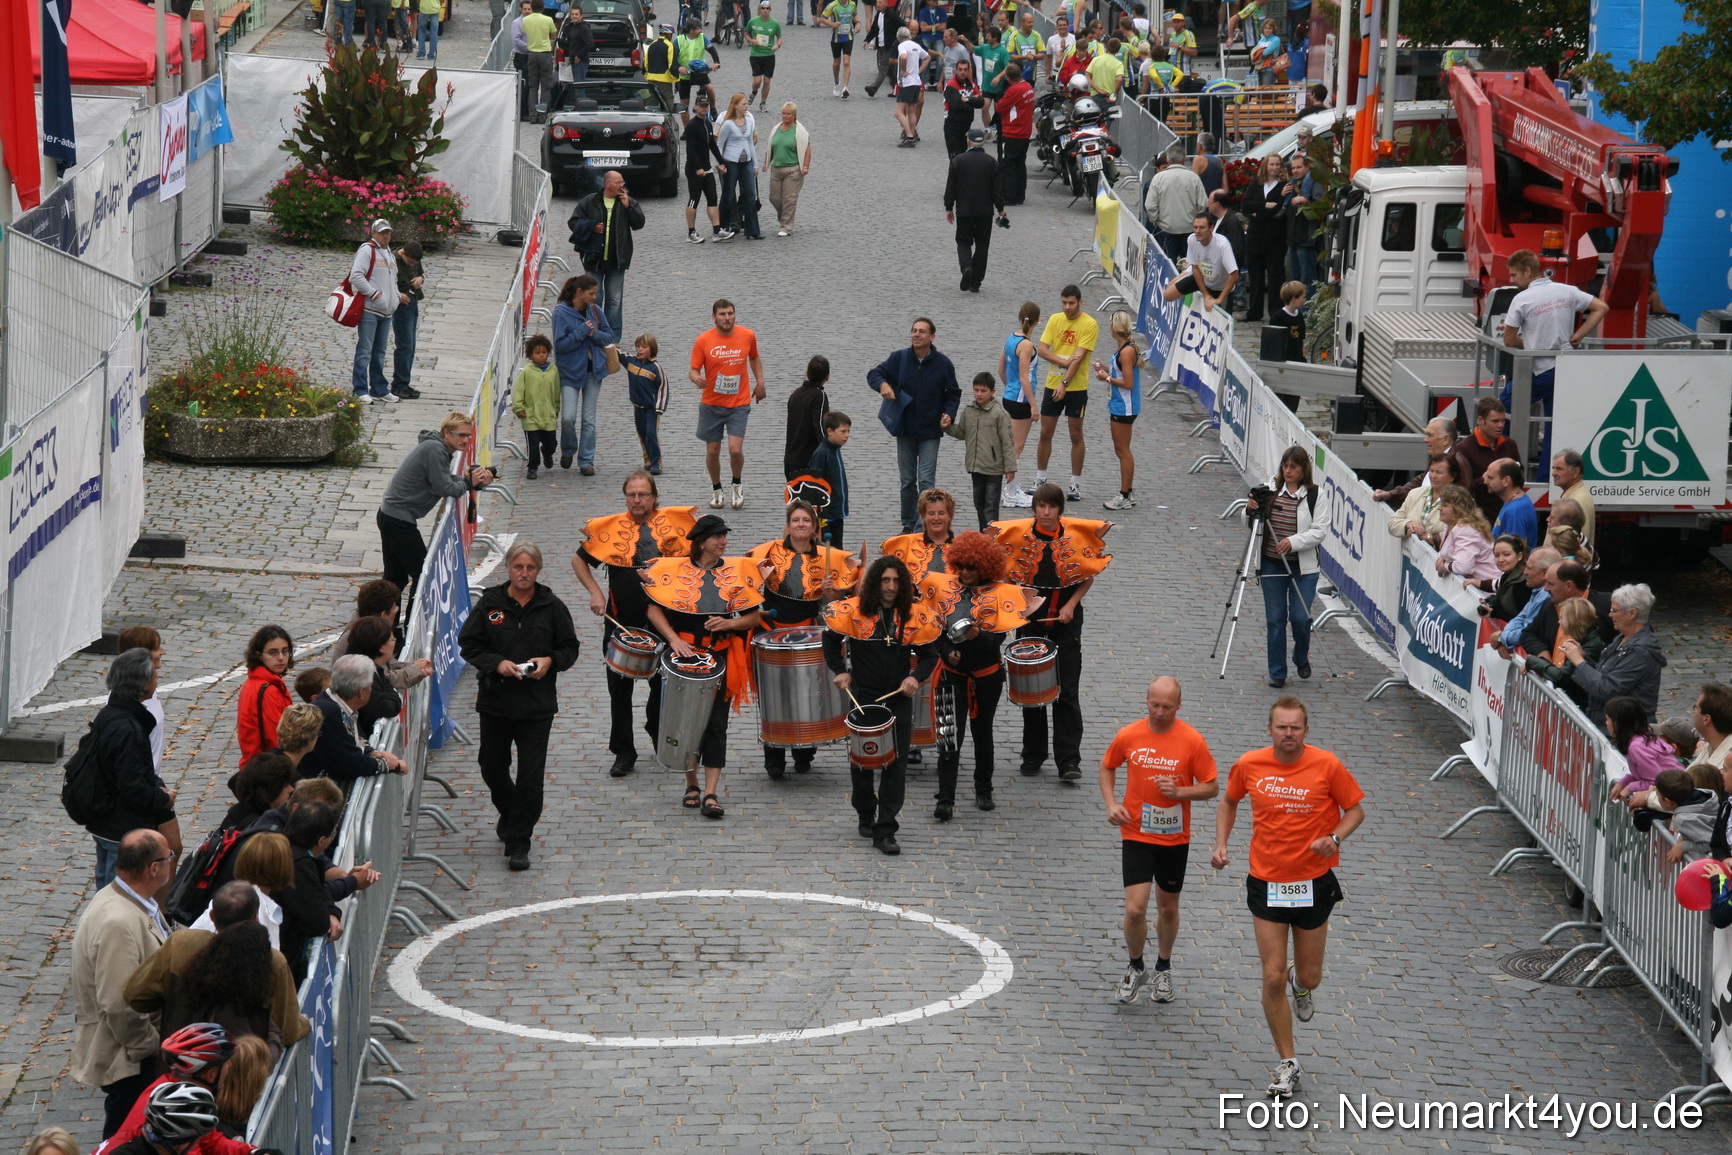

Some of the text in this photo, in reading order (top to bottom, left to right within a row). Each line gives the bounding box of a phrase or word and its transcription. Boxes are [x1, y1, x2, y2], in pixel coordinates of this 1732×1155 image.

[1086, 156, 1096, 164] NM
[1090, 162, 1102, 170] 308
[1589, 485, 1711, 497] Gebäude Service GmbH
[1415, 603, 1466, 670] Tagblatt
[1137, 753, 1180, 767] Fischer
[1141, 763, 1176, 771] AUTOMOBILE
[1264, 781, 1310, 796] Fischer
[1267, 792, 1306, 801] AUTOMOBILE
[1153, 815, 1179, 826] 3585
[1280, 884, 1308, 895] 3583
